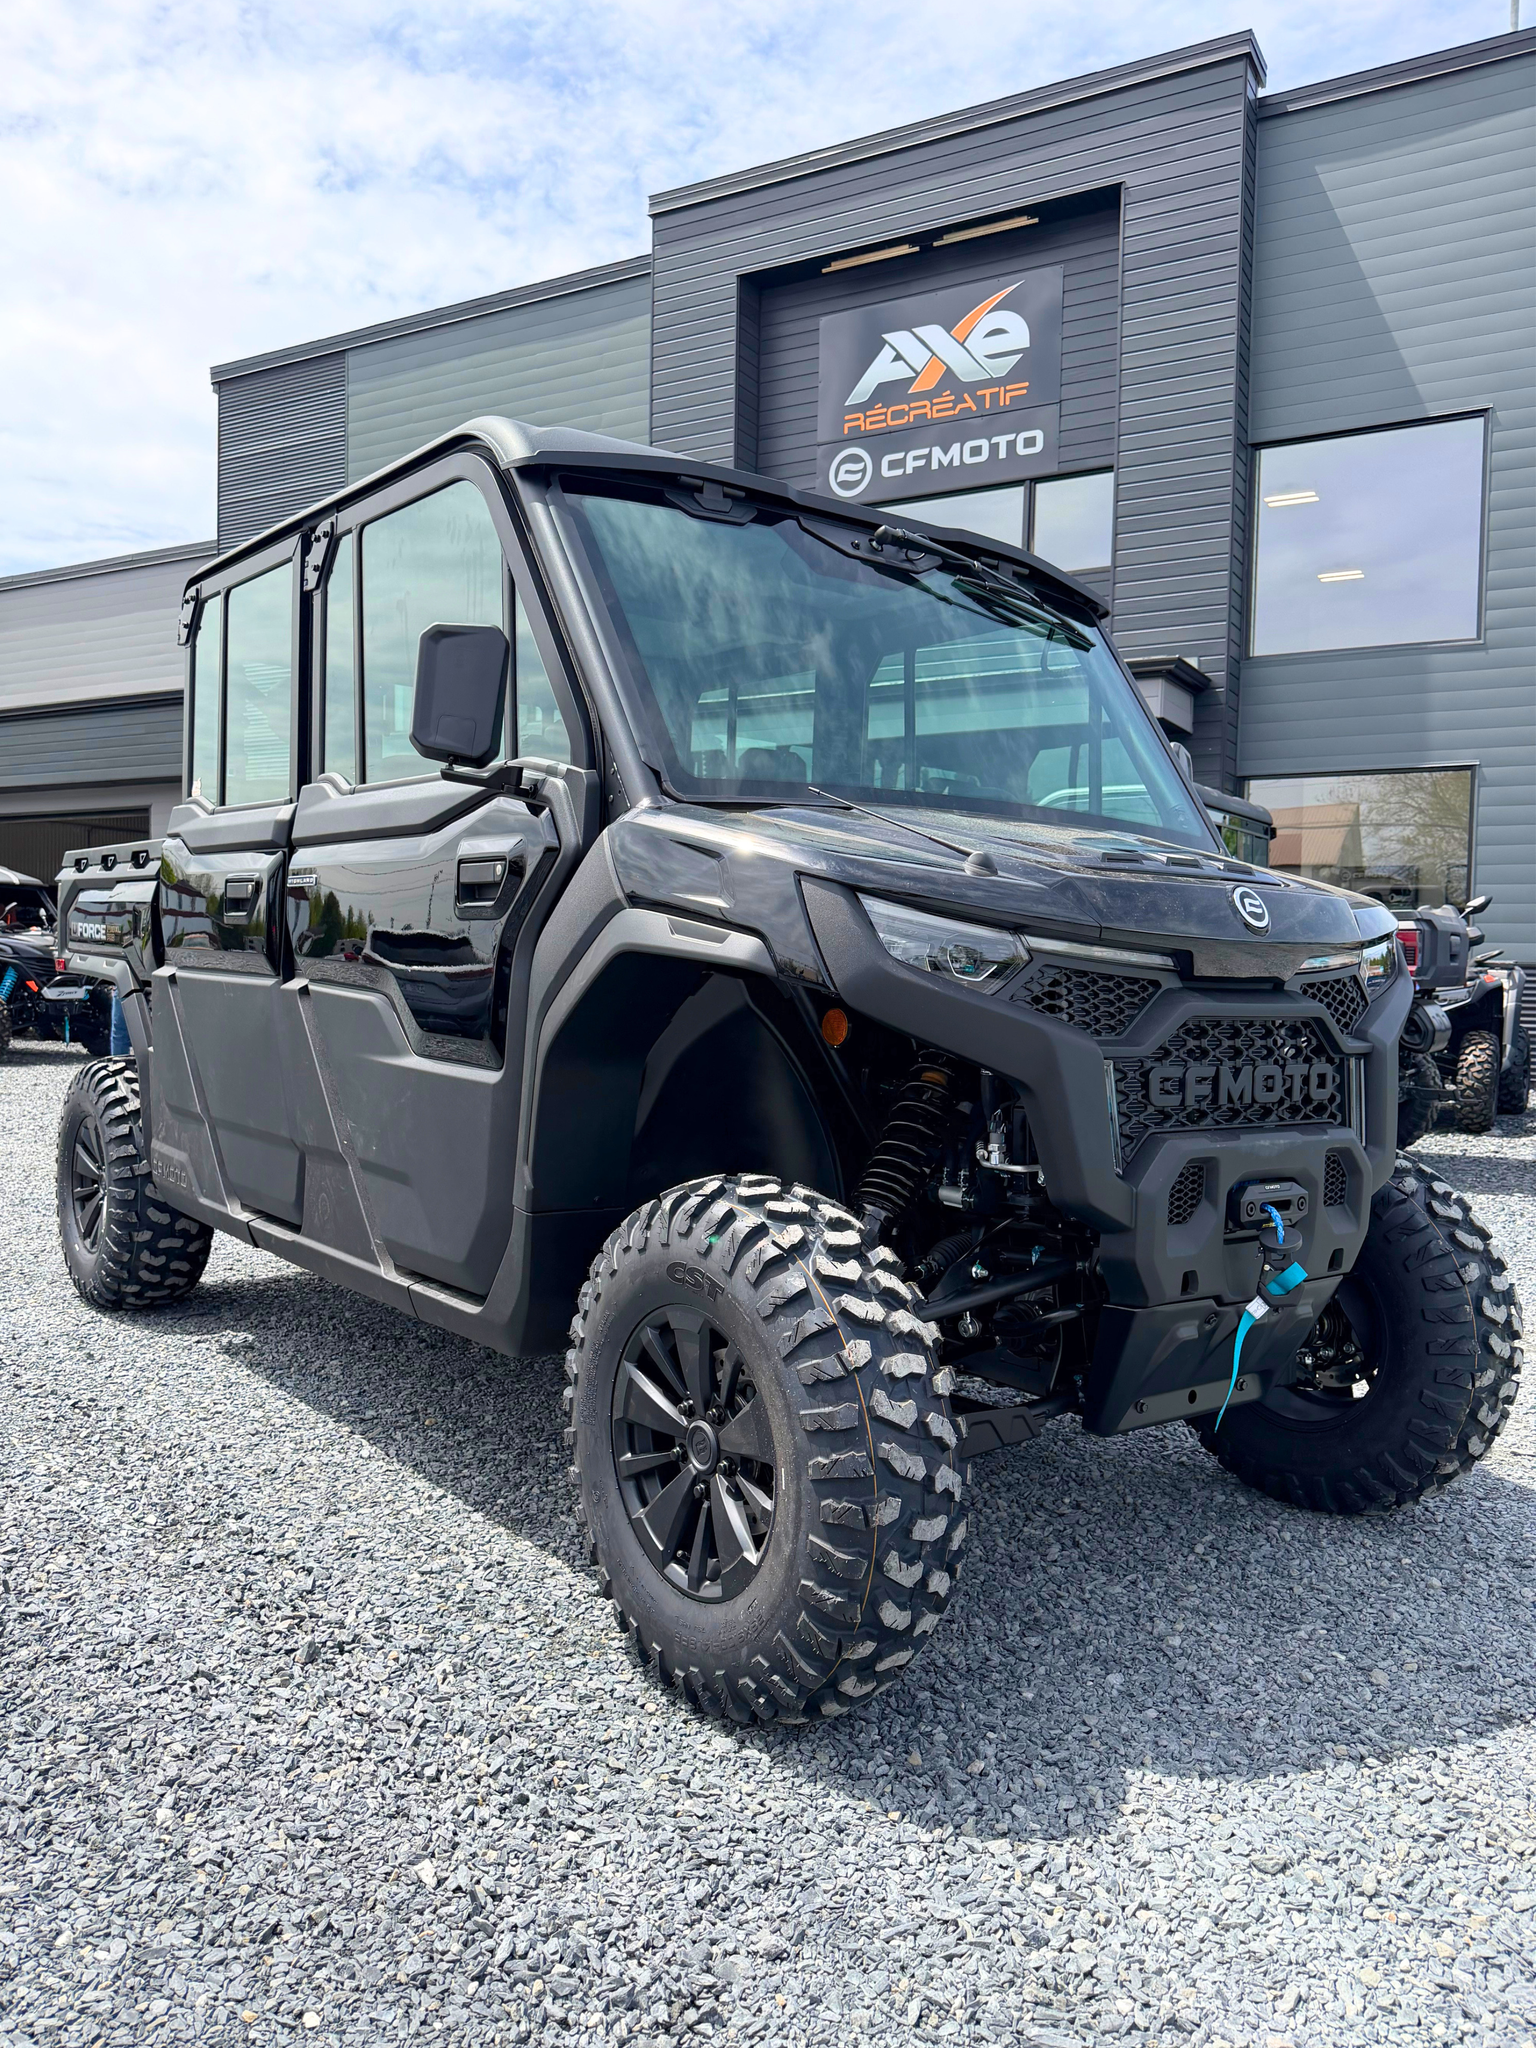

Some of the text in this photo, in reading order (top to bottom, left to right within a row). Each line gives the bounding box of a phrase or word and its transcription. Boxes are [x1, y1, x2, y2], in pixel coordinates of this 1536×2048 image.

[843, 381, 1030, 435] RÉCRÉATIF
[881, 429, 1044, 478] CFMOTO
[1150, 1063, 1333, 1107] CFMOTO
[666, 1260, 725, 1302] CST
